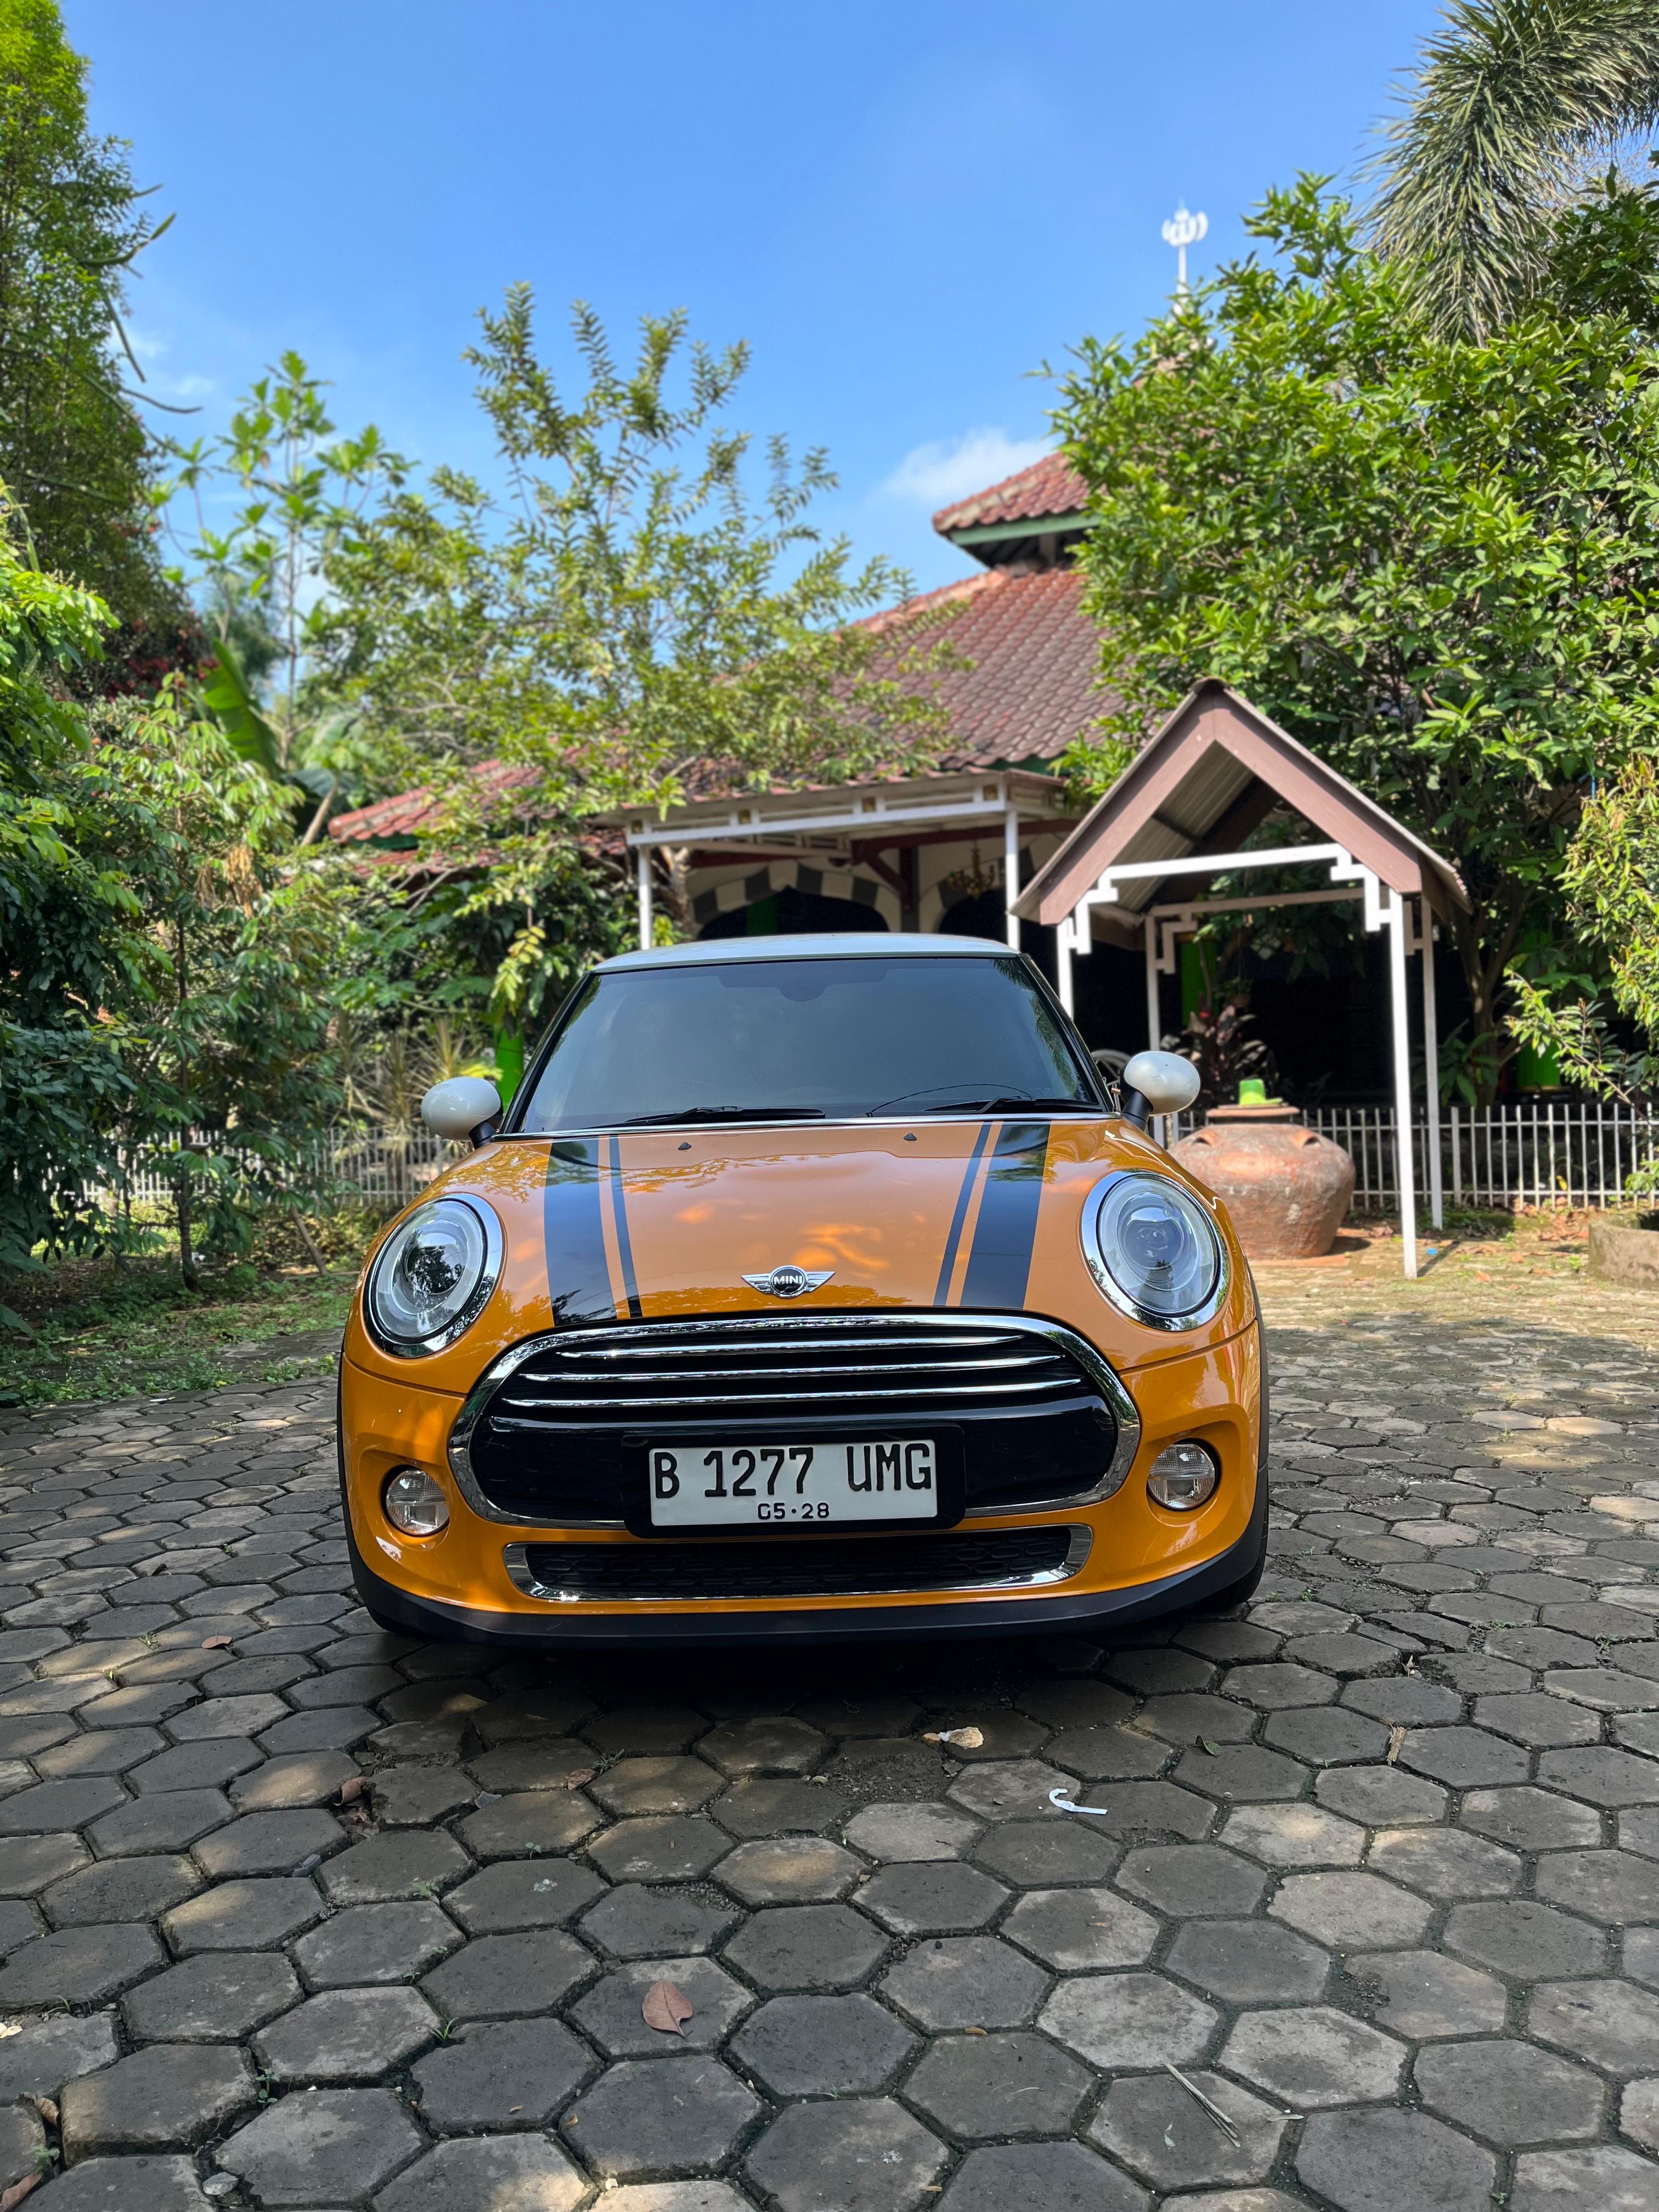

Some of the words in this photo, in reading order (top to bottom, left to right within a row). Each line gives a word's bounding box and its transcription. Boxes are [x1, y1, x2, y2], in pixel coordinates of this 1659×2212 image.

[774, 1275, 803, 1285] MINI
[653, 1451, 680, 1500] B
[703, 1446, 814, 1498] 1277
[845, 1442, 932, 1493] UMG
